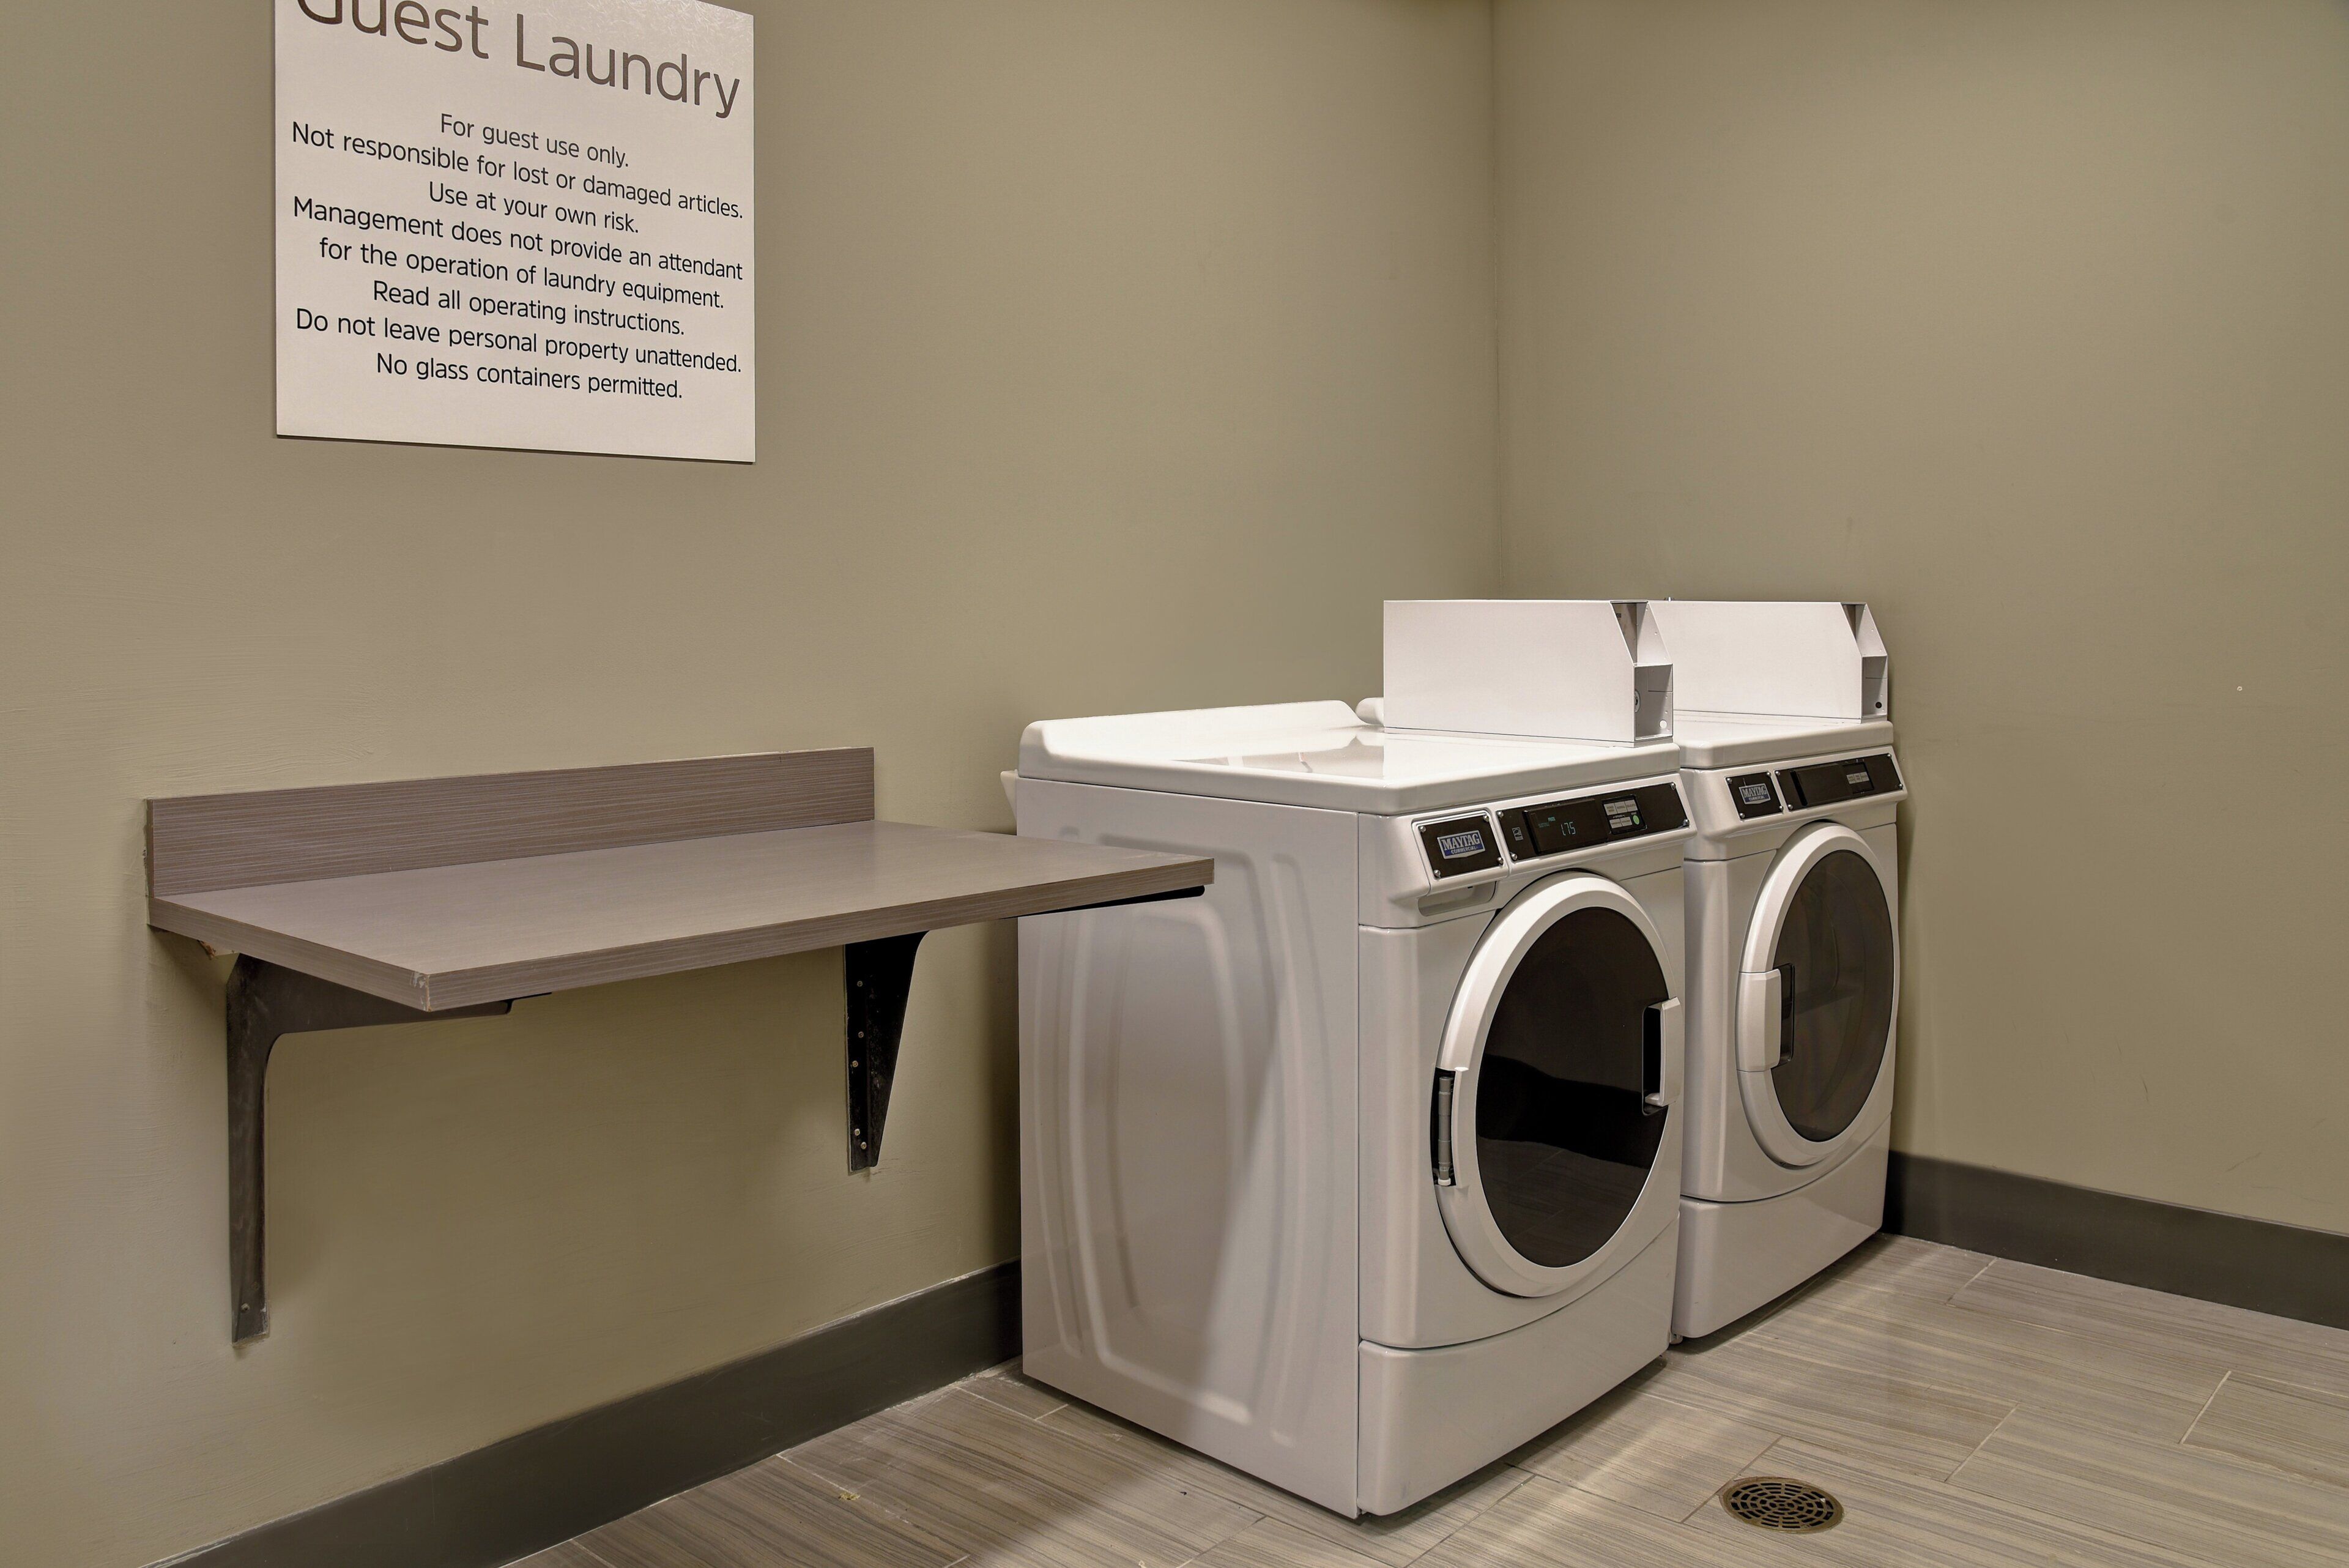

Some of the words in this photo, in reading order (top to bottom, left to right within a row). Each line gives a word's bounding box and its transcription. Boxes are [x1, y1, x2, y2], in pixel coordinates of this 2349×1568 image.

[516, 13, 740, 119] Laundry
[441, 113, 475, 138] For
[482, 126, 540, 151] guest
[546, 138, 580, 158] use
[587, 146, 629, 169] only.
[292, 121, 335, 149] Not
[343, 135, 469, 173] responsible
[476, 154, 506, 178] for
[514, 160, 549, 186] lost
[555, 173, 576, 190] or
[583, 174, 671, 207] damaged
[678, 194, 743, 219] articles.
[429, 180, 469, 207] Use
[475, 191, 497, 212] at
[503, 198, 548, 219] your
[555, 206, 596, 227] own
[604, 210, 639, 234] risk.
[294, 195, 444, 238] Management
[451, 220, 502, 246] does
[510, 232, 544, 252] not
[551, 239, 623, 263] provide
[629, 250, 651, 267] an
[658, 253, 743, 281] attendant
[319, 237, 352, 261] for
[360, 243, 398, 267] the
[406, 253, 508, 281] operation
[516, 265, 537, 284] of
[544, 266, 616, 297] laundry
[622, 282, 724, 309] equipment.
[374, 280, 429, 307] Read
[437, 289, 461, 310] all
[469, 296, 566, 325] operating
[574, 304, 685, 335] instructions.
[297, 308, 328, 332] Do
[338, 316, 376, 337] not
[384, 317, 440, 343] leave
[449, 329, 537, 353] personal
[545, 338, 629, 364] property
[636, 348, 741, 373] unattended.
[377, 352, 407, 376] No
[416, 357, 469, 381] glass
[477, 366, 581, 390] containers
[588, 376, 682, 399] permitted.
[1742, 786, 1767, 798] MAYTAG
[1441, 833, 1480, 851] MAYTAG
[1451, 845, 1477, 855] COMMERCIAL
